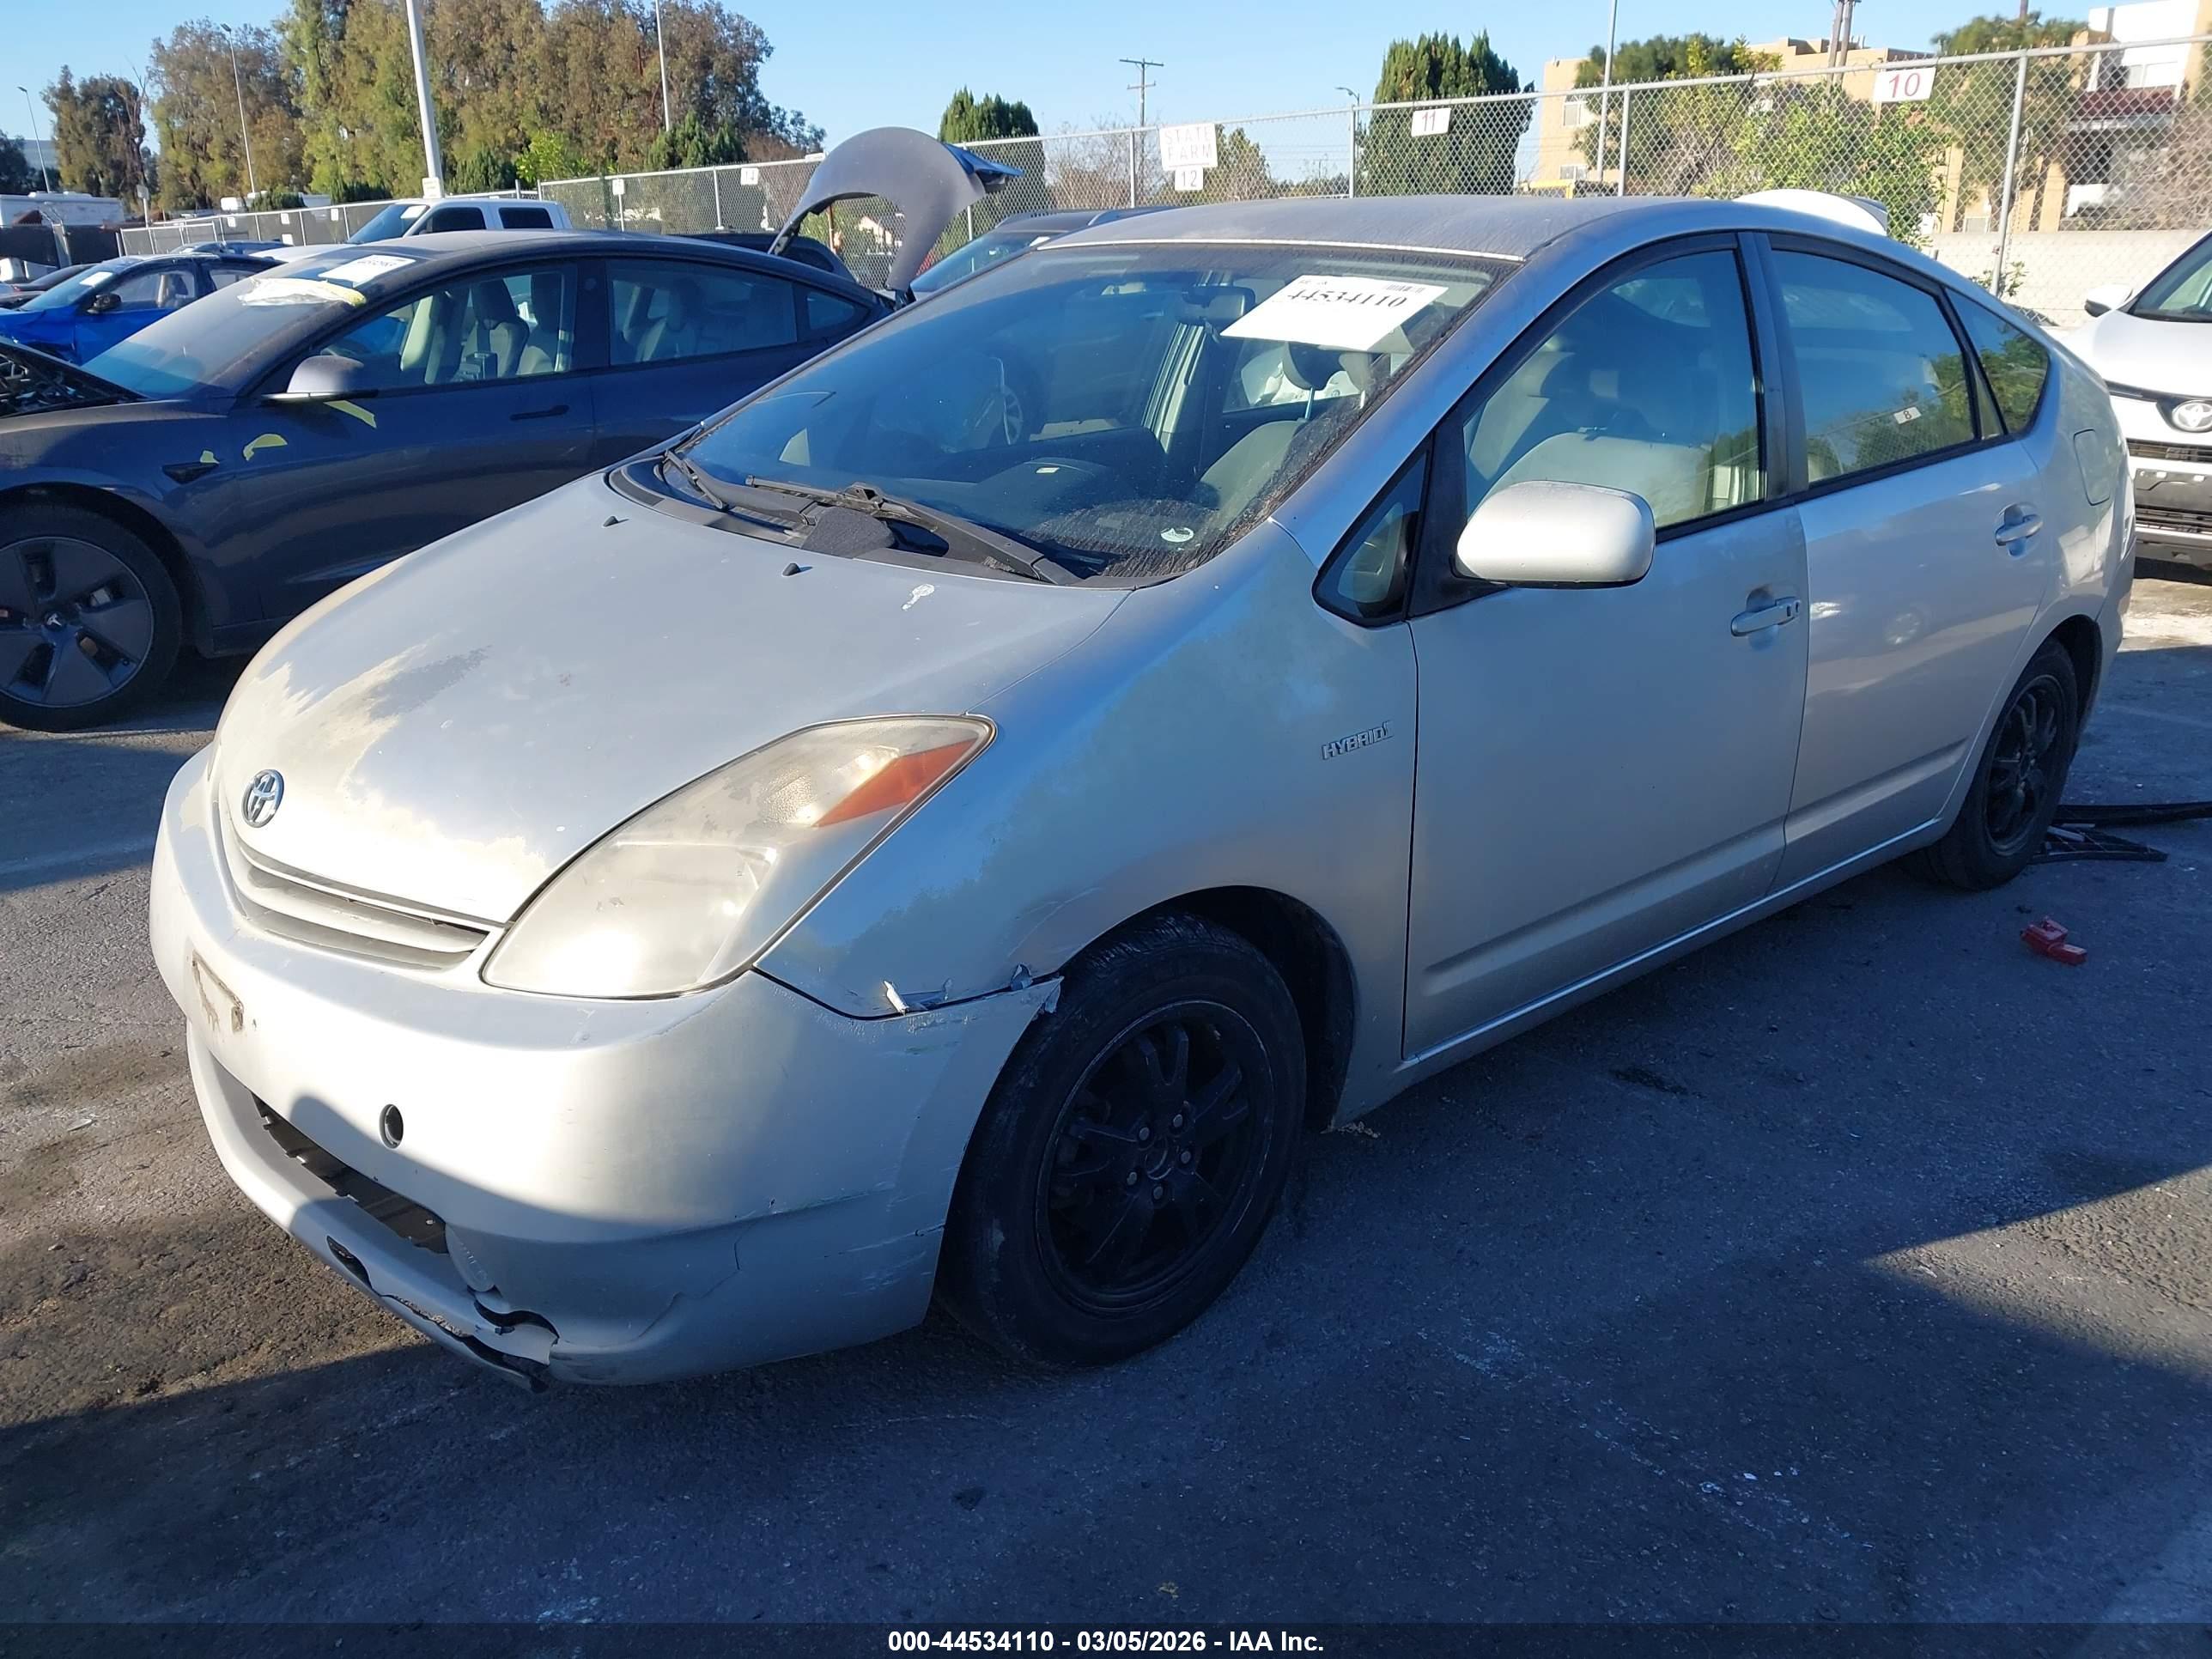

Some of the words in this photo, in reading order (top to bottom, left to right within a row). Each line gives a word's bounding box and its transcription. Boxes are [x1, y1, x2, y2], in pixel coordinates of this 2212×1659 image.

[1889, 72, 1920, 99] 10
[1422, 111, 1436, 132] 11
[1164, 126, 1212, 145] STATE
[1168, 143, 1212, 161] FARM
[1182, 169, 1198, 188] 12
[1322, 726, 1385, 761] HYBRID
